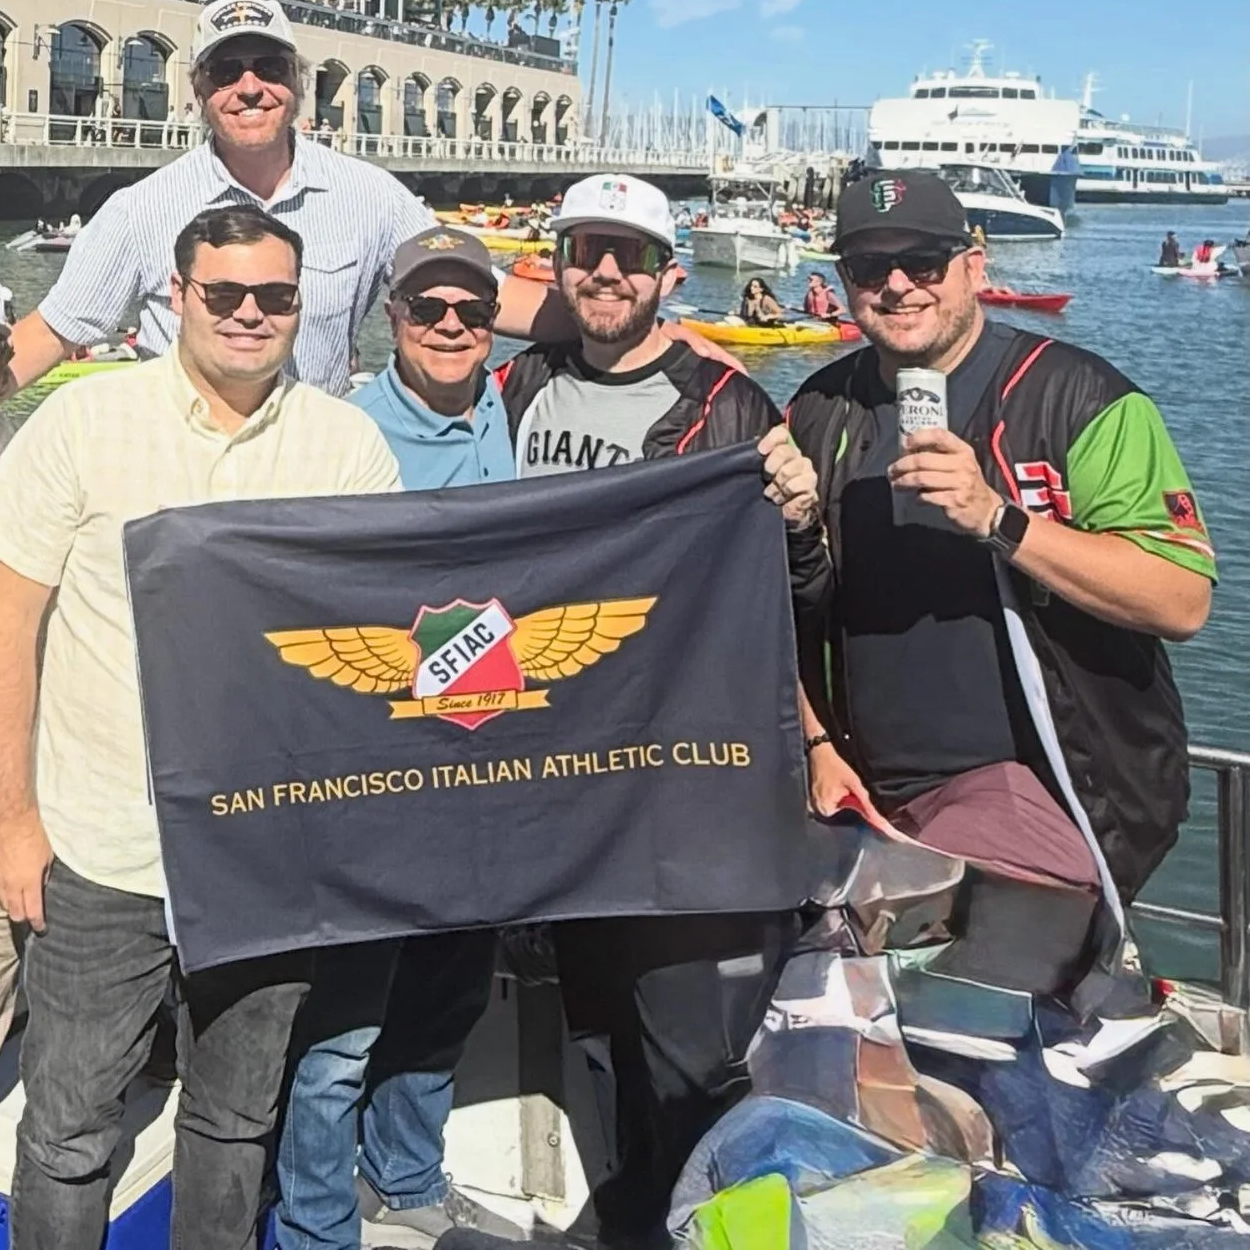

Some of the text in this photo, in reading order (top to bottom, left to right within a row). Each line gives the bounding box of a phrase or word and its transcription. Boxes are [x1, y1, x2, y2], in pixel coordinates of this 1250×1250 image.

[527, 429, 632, 470] GIANT
[428, 622, 496, 684] SFIAC
[436, 692, 506, 710] Since 1917
[210, 742, 751, 817] SAN FRANCISCO ITALIAN ATHLETIC CLUB
